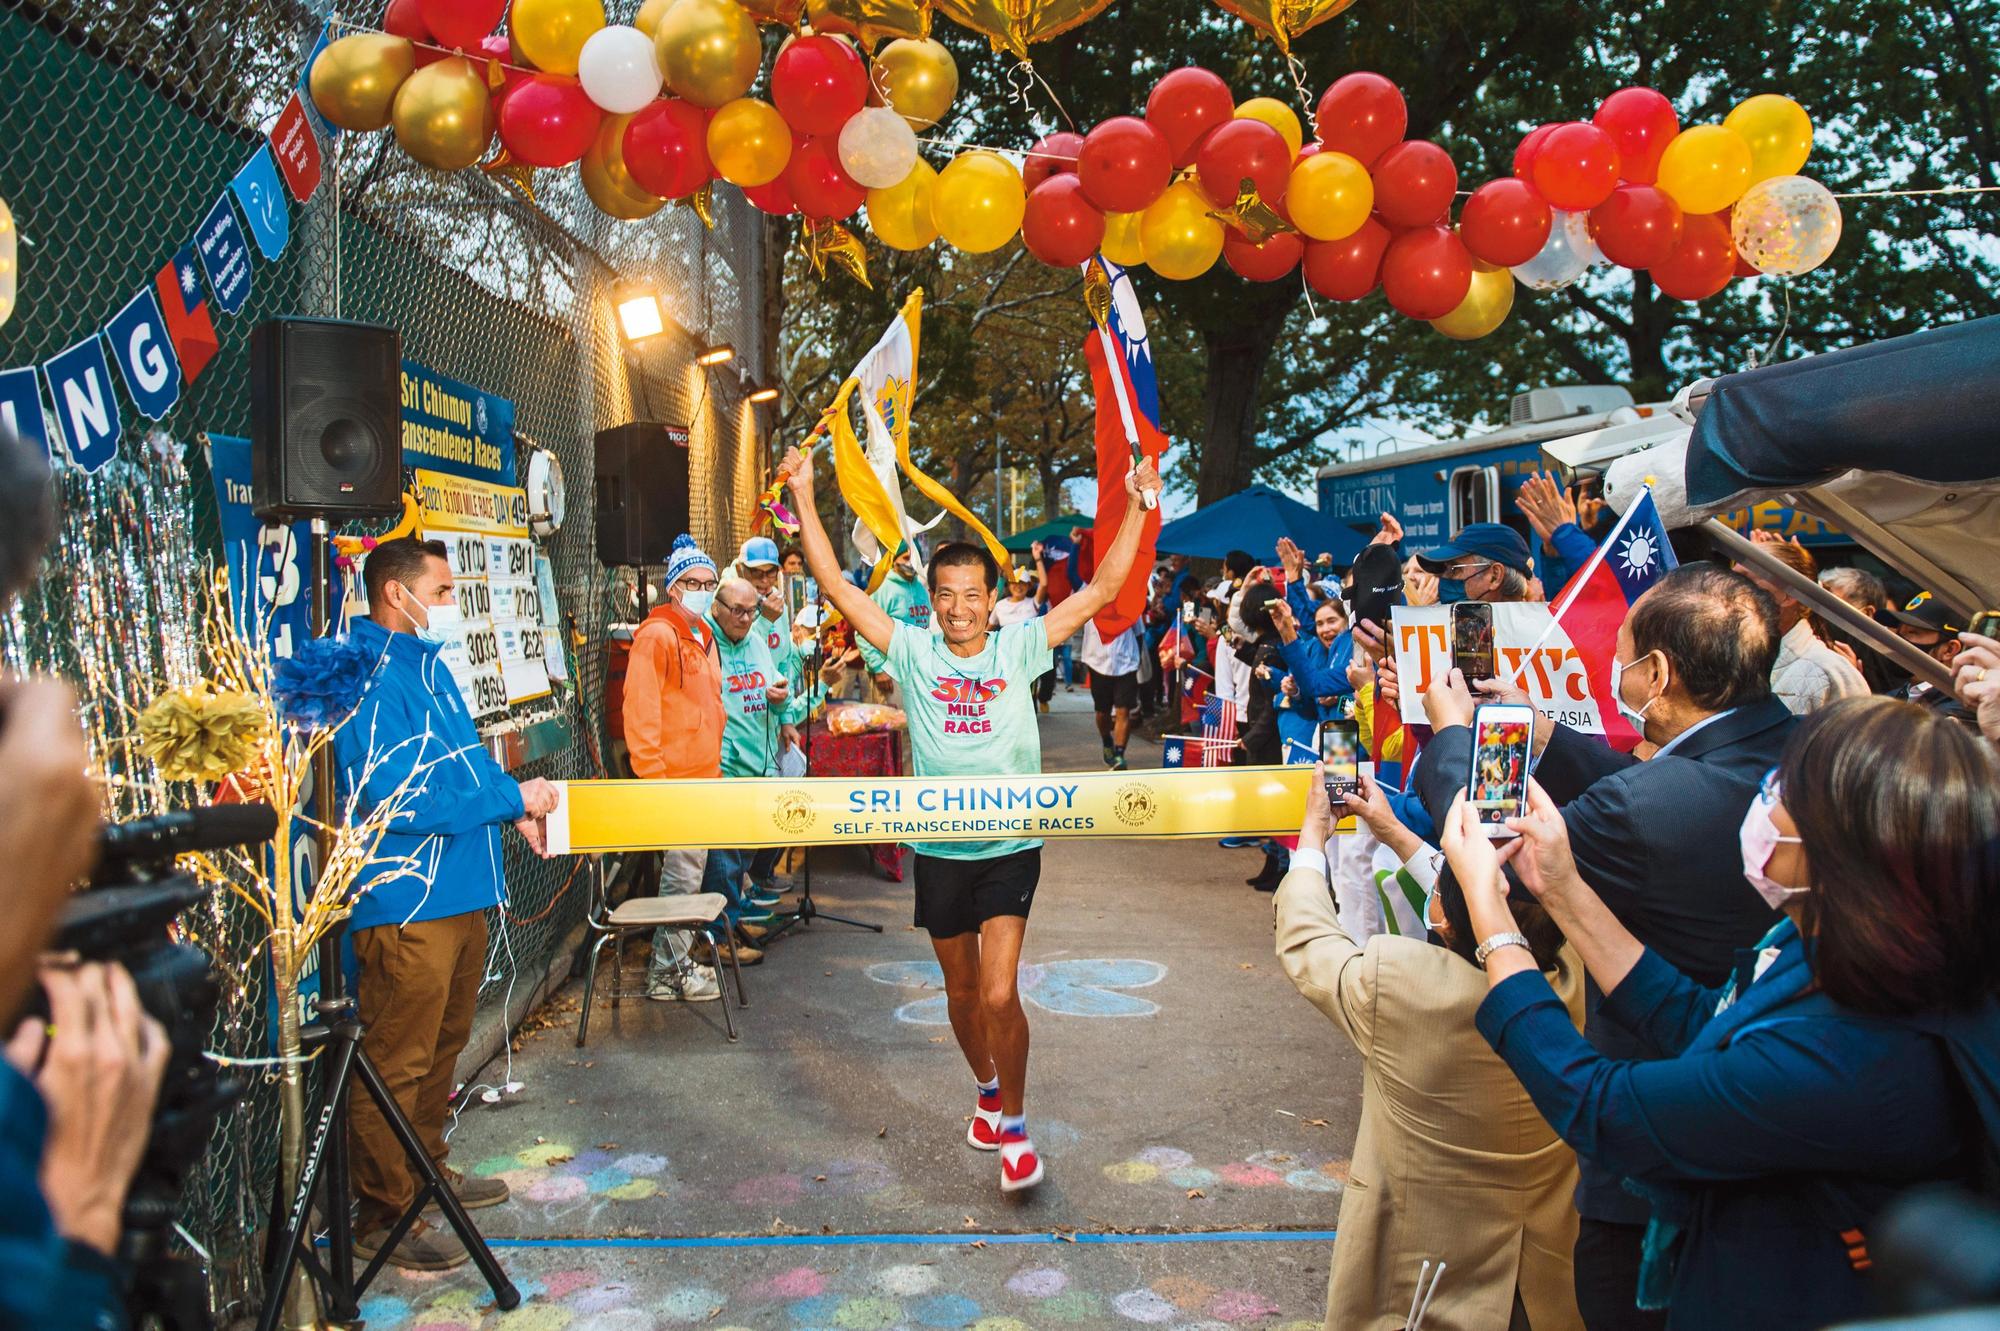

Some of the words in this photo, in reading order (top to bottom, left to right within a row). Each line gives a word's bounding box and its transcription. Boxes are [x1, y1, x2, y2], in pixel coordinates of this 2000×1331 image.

[218, 240, 230, 259] our
[401, 371, 419, 410] Sri
[423, 379, 471, 431] Chinmoy
[402, 420, 472, 465] anscendence
[474, 435, 502, 472] Races
[668, 431, 688, 442] 1100
[462, 492, 479, 517] MILE
[478, 496, 494, 519] RACE
[493, 494, 511, 525] DAY
[512, 494, 526, 525] 49
[1334, 489, 1367, 518] PEACE
[1370, 485, 1397, 515] RUN
[509, 543, 534, 575] 2911
[461, 582, 490, 618] 3100
[466, 631, 498, 666] 3033
[472, 676, 508, 710] 2969
[743, 693, 762, 702] MILE
[743, 703, 767, 714] RACE
[948, 703, 986, 717] MILE
[1560, 711, 1592, 726] ASIA
[944, 720, 992, 734] RACE
[849, 789, 901, 813] SRI
[917, 785, 1079, 812] CHINMOY
[834, 818, 1033, 835] SELF-TRANSCENDENCE
[1040, 817, 1094, 831] RACES
[287, 1105, 331, 1232] ULTIMATE
